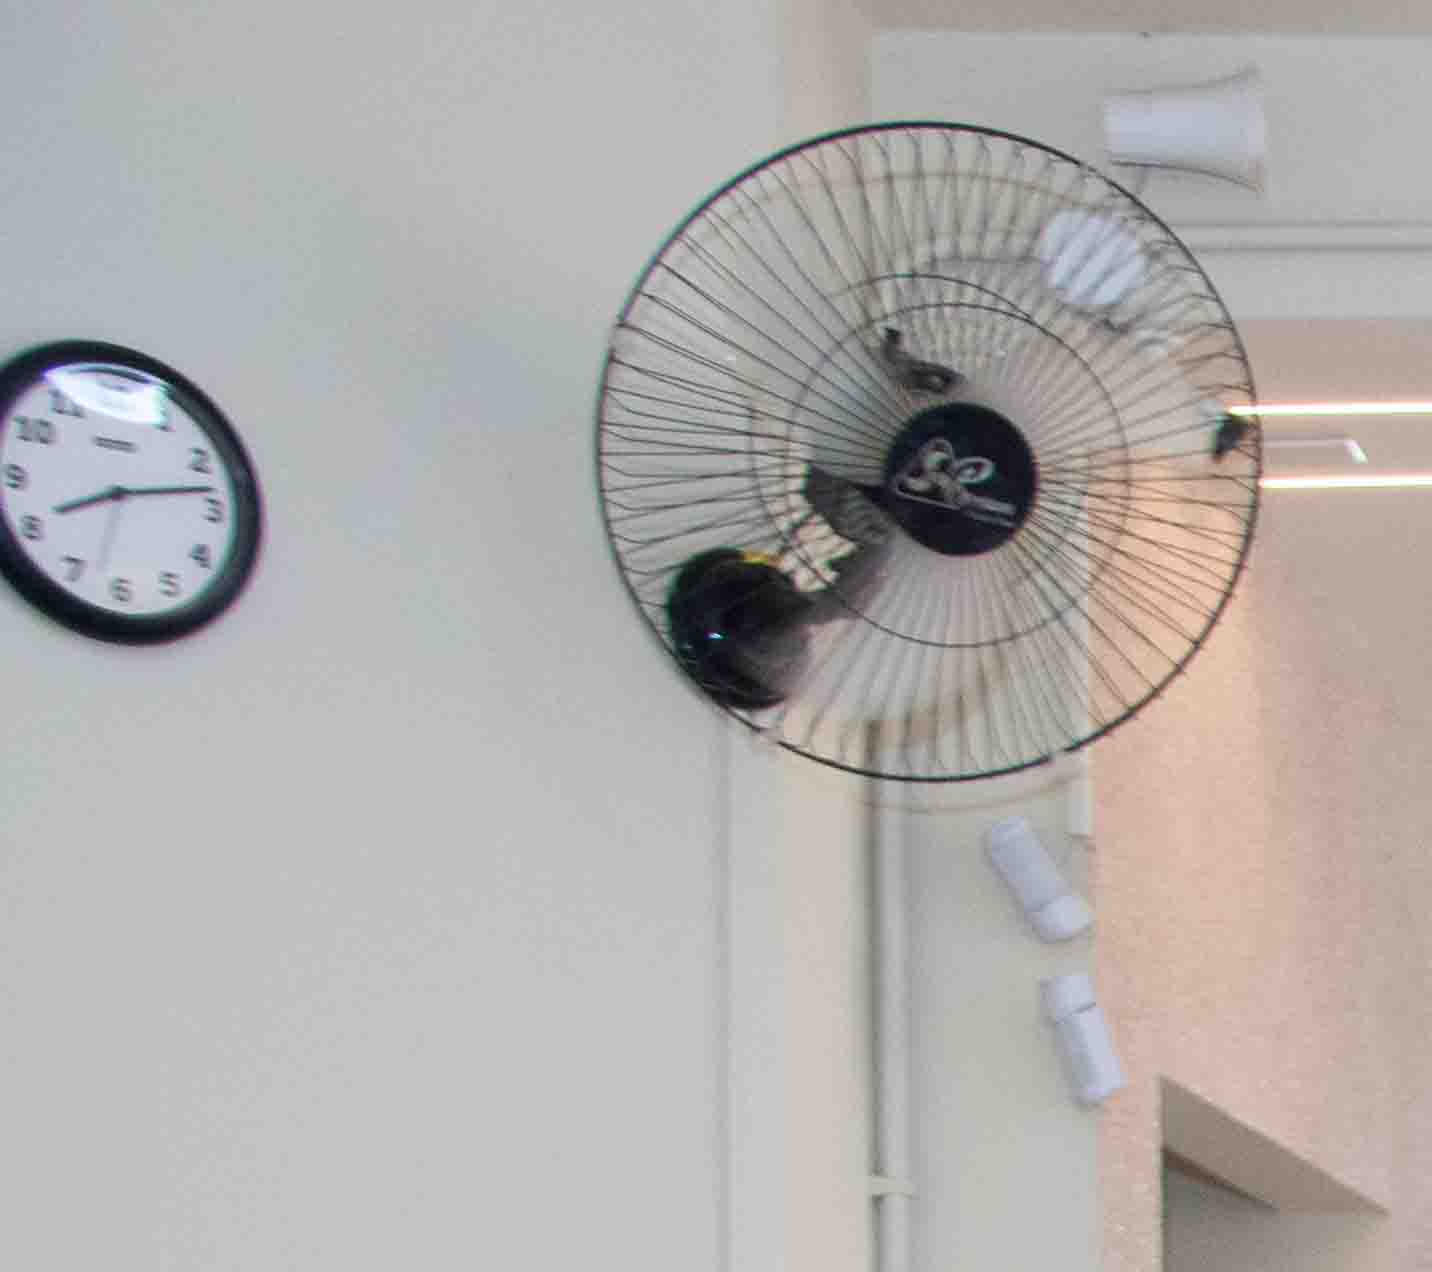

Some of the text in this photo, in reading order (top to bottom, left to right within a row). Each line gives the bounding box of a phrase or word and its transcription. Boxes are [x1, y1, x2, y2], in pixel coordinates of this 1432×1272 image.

[13, 415, 56, 445] 10
[188, 447, 213, 475] 2
[3, 463, 27, 490] 9
[203, 497, 225, 524] 3
[20, 513, 43, 541] 8
[61, 554, 86, 582] 7
[189, 543, 212, 570] 4
[108, 576, 133, 603] 6
[157, 571, 181, 598] 5
